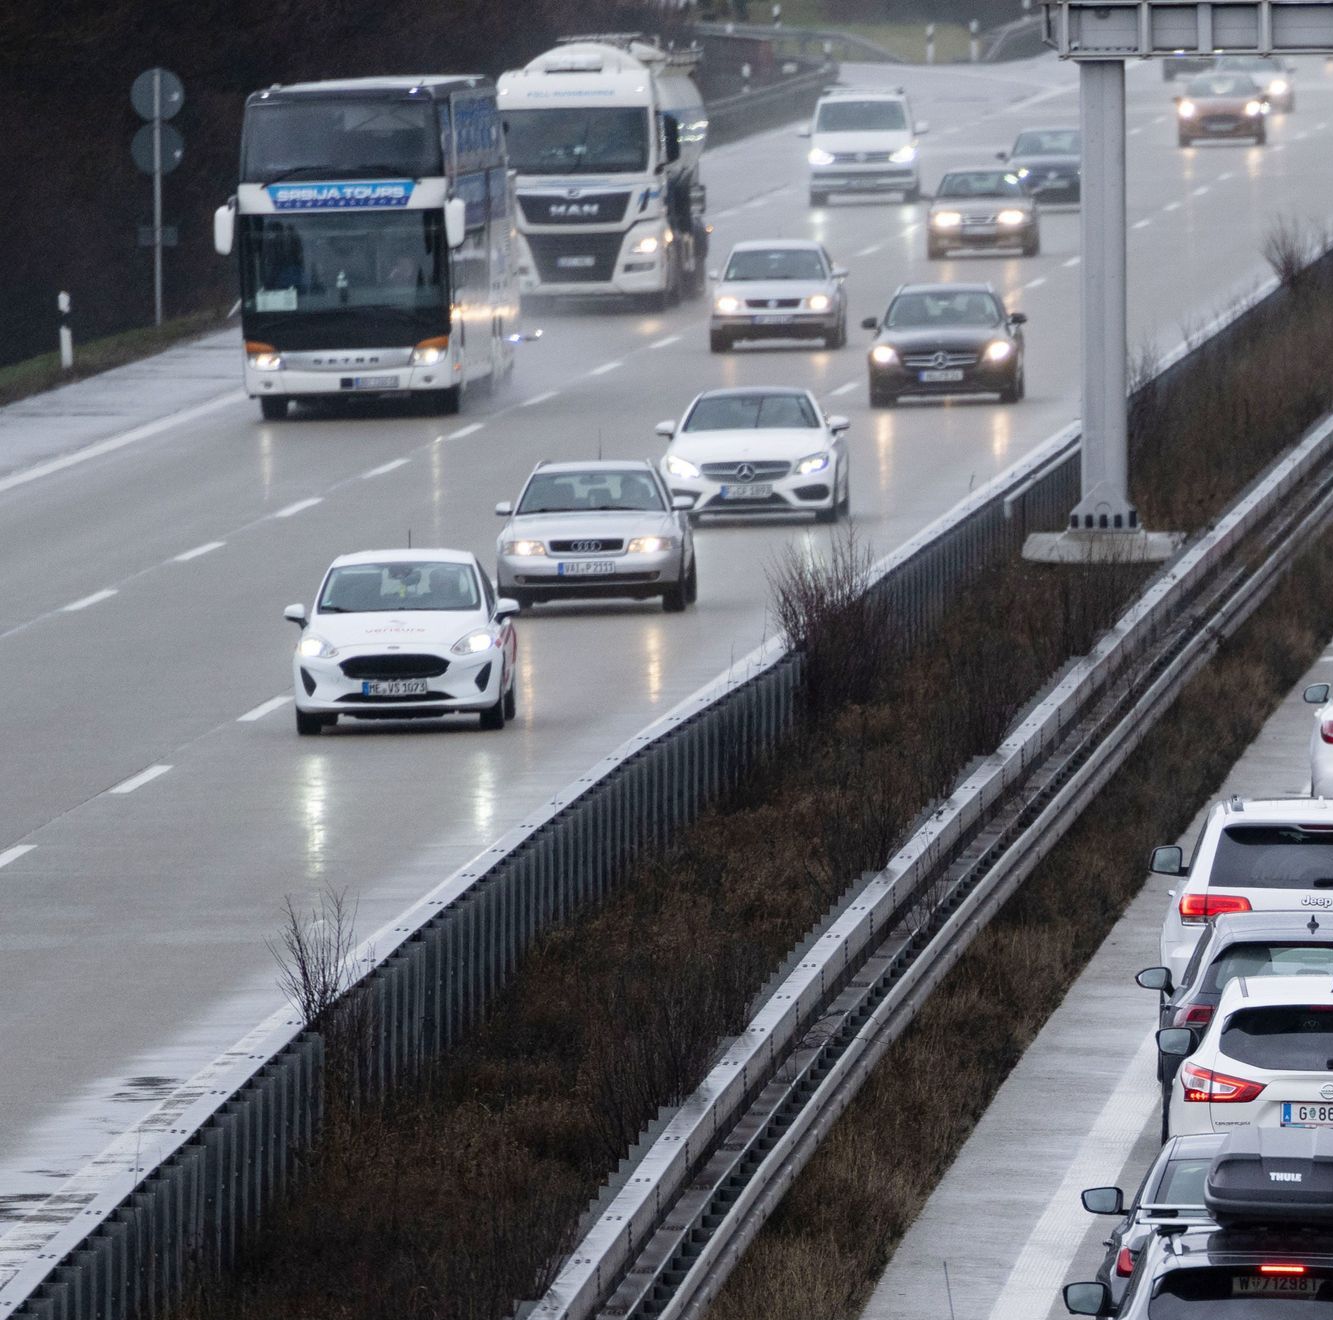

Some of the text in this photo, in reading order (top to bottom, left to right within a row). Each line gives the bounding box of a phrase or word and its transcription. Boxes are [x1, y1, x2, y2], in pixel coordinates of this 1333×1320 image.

[342, 184, 406, 200] TOURS
[549, 203, 600, 216] MAN
[387, 681, 400, 693] VS
[402, 680, 426, 692] 1073
[1301, 895, 1332, 908] Jeep
[1299, 1107, 1308, 1121] G
[1269, 1172, 1302, 1182] THULE
